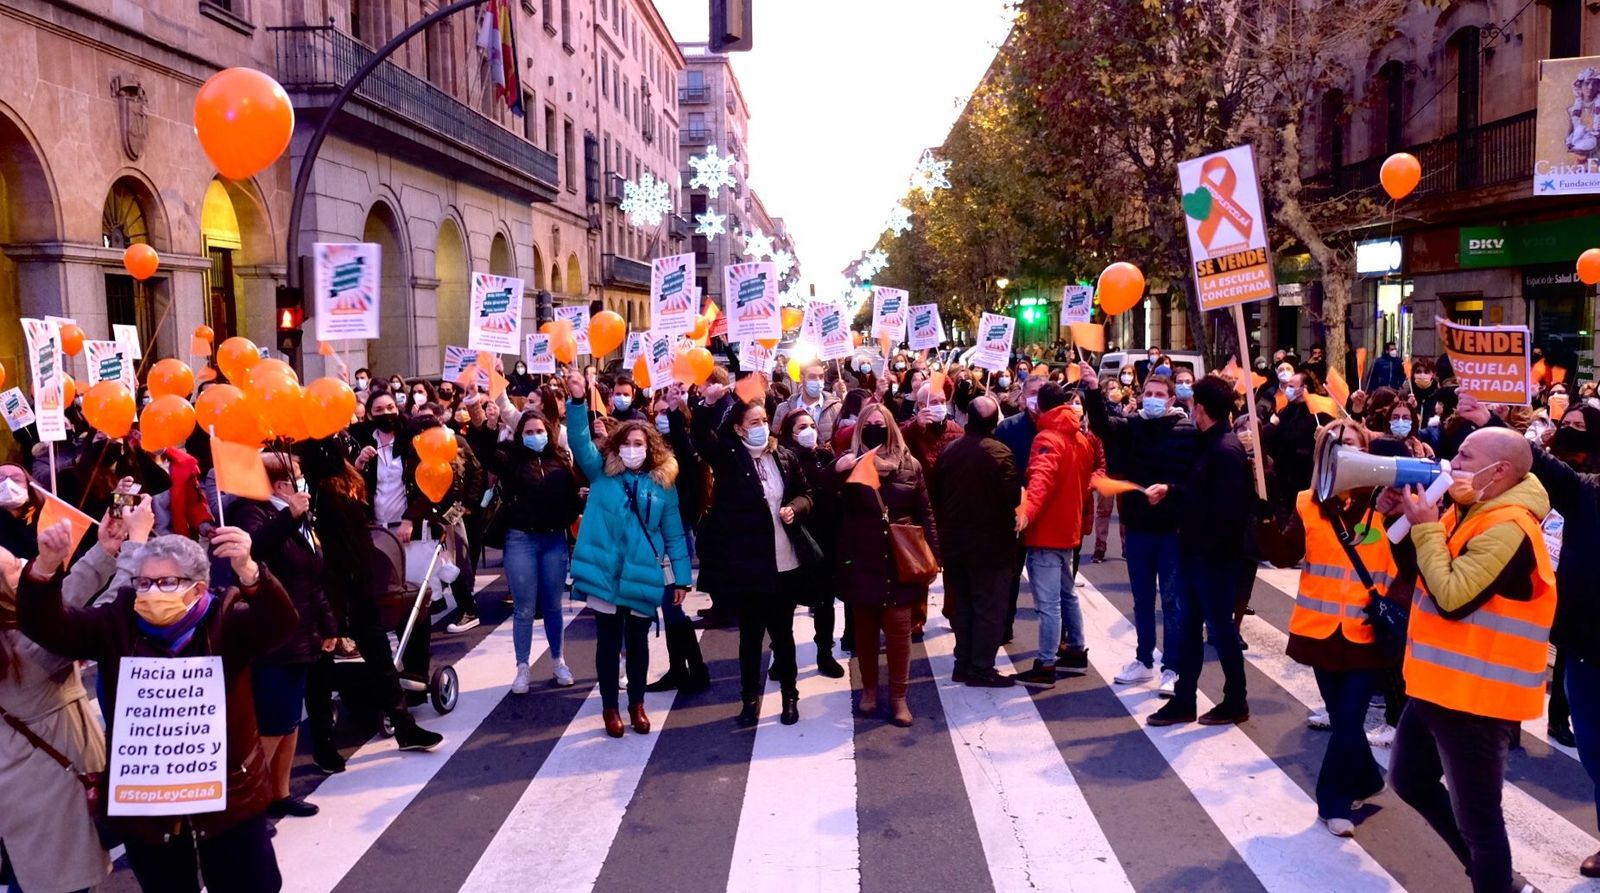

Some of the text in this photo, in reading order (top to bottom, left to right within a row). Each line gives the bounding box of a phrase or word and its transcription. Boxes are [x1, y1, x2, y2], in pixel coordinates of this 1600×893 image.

[1535, 158, 1600, 175] CaixaF
[1469, 239, 1504, 250] DKV
[1197, 259, 1215, 277] SE
[1218, 249, 1267, 273] VENDE
[1203, 269, 1265, 290] LA ESCUELA
[1554, 273, 1572, 284] Salud
[1201, 280, 1271, 302] CONCERTADA
[1452, 329, 1523, 353] VENDE
[1453, 359, 1518, 375] ESCUELA
[1458, 377, 1525, 392] ERTADA
[130, 666, 213, 680] Hacia una
[137, 685, 204, 699] escuela
[125, 704, 216, 718] realmente
[129, 722, 210, 737] inclusiva
[118, 741, 222, 756] con todos y
[120, 760, 217, 777] para todos
[119, 785, 215, 801] #StopLeyCelaá
